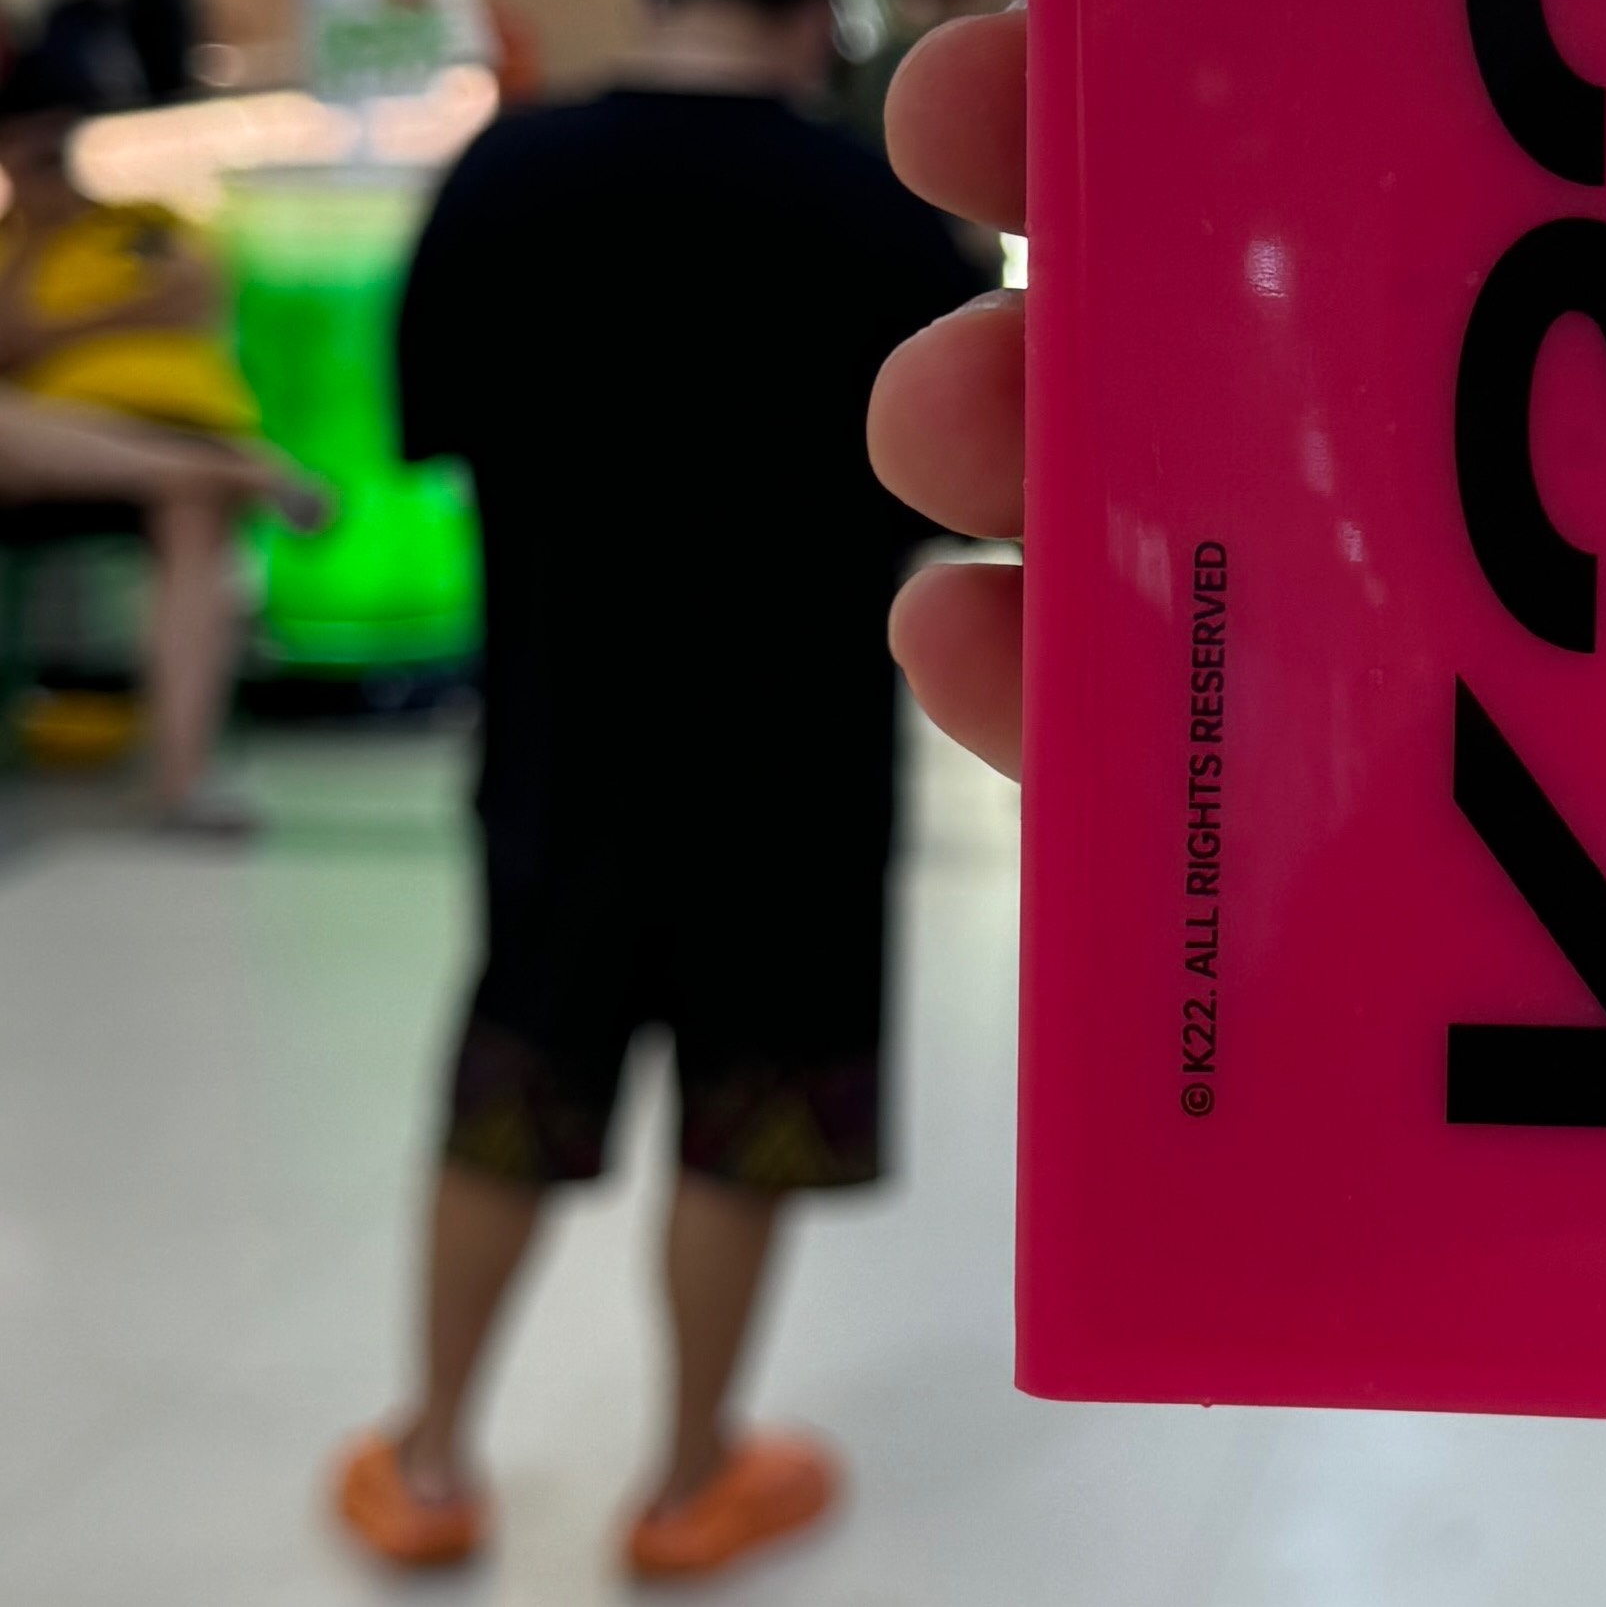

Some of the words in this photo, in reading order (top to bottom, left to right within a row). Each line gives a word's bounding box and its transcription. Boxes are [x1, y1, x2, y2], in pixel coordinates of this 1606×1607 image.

[1189, 541, 1227, 743] RESERVED
[1186, 754, 1223, 896] RIGHTS
[1184, 906, 1219, 979] ALL
[1182, 989, 1217, 1074] K22.
